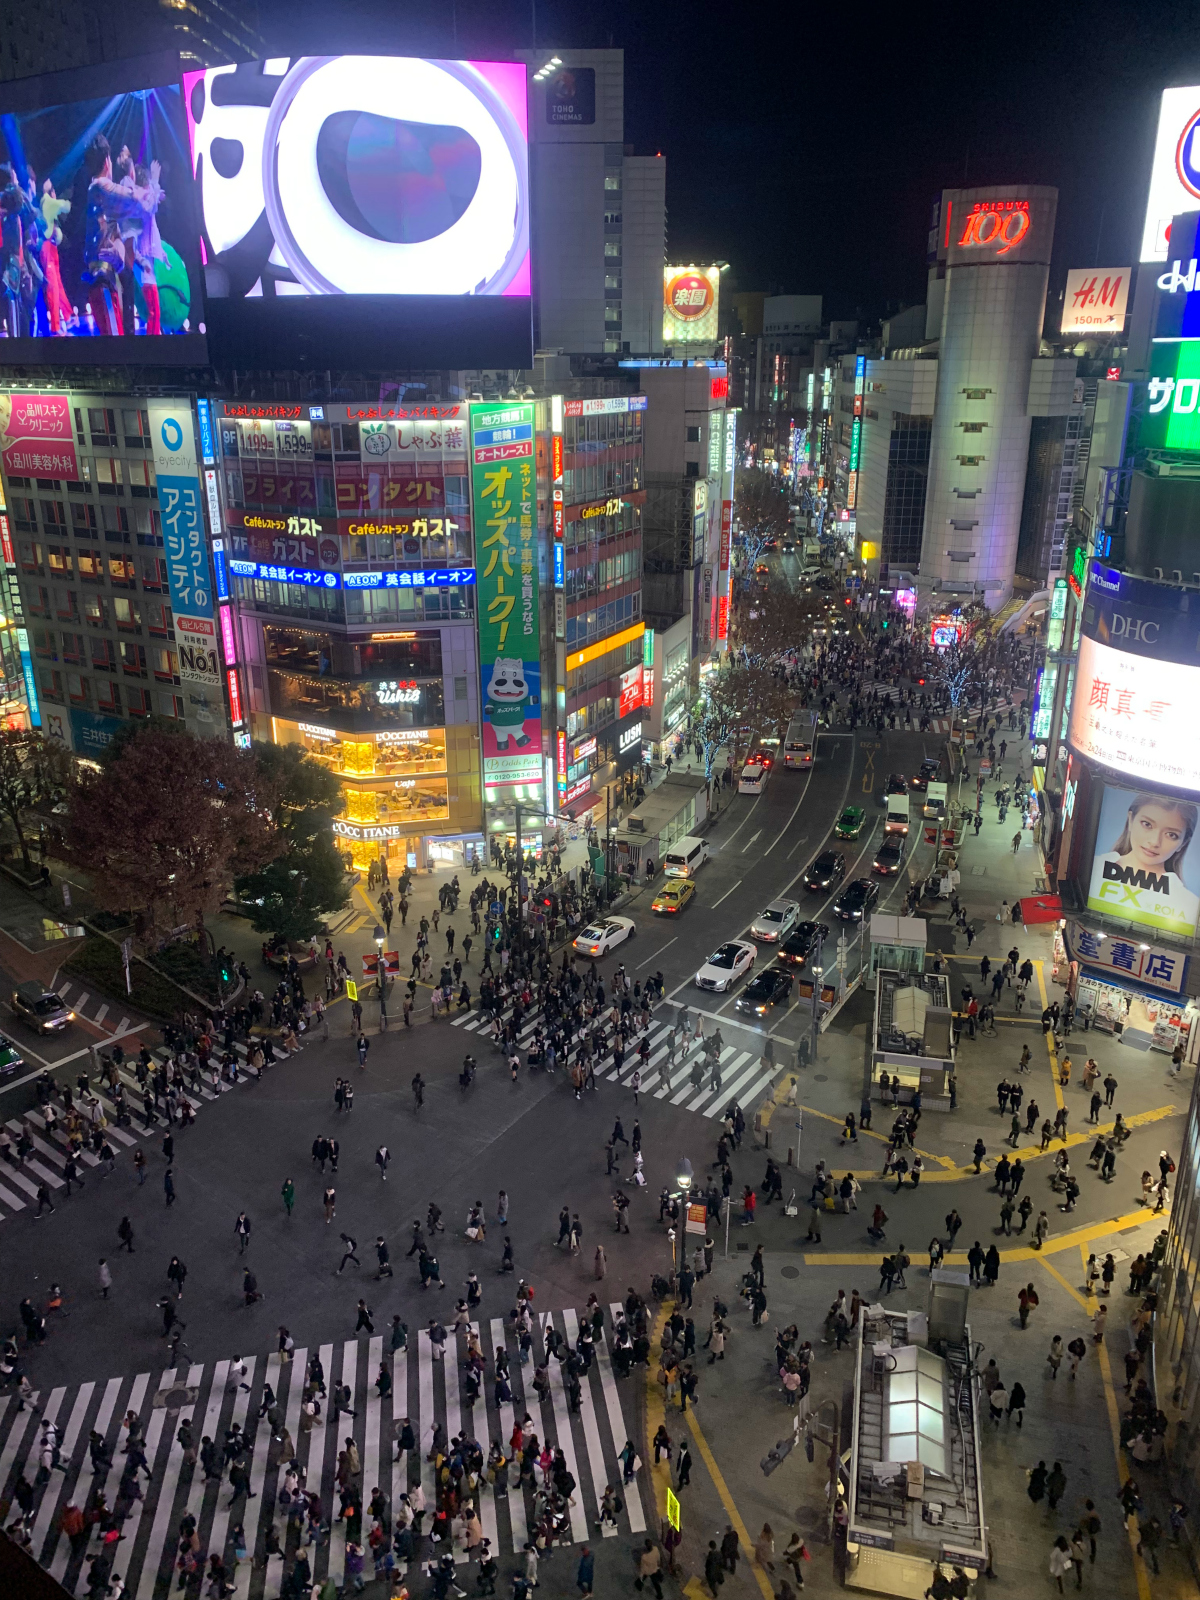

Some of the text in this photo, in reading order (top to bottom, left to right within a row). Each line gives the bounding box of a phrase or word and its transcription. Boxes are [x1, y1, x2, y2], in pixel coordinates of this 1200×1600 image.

[552, 105, 574, 113] TOHO
[552, 113, 582, 121] CINEMAS
[973, 201, 1030, 212] SHIBUYA
[957, 210, 1030, 254] 109
[674, 288, 707, 306] 楽園
[1072, 275, 1123, 309] H&M
[1075, 315, 1102, 325] 150m
[27, 404, 66, 418] 品川スキン
[224, 404, 302, 419] しゃぶしゃぶバイキング
[347, 406, 461, 419] しゃぶしゃぶバイキング
[29, 418, 64, 432] クリニック
[200, 407, 211, 455] 東急リバブル
[222, 431, 237, 444] 9F
[397, 427, 463, 450] しゃぶ葉
[725, 413, 735, 473] BIC CAMERA
[13, 452, 74, 473] 品川美容外科
[158, 455, 192, 469] eyecity
[244, 477, 314, 500] プライス
[338, 481, 441, 502] コンタクト
[847, 475, 856, 506] HOOTERS
[606, 498, 625, 517] ガスト
[287, 517, 323, 537] ガスト
[412, 518, 459, 537] ガスト
[162, 487, 190, 605] アイシティ
[183, 489, 208, 607] コンタクトの
[233, 536, 248, 551] 7F
[272, 538, 315, 564] ガスト
[519, 463, 534, 636] ネットで馬券・車券を買うなら
[721, 529, 730, 564] TaxFree
[234, 564, 255, 575] AEON
[259, 565, 322, 584] 英会話イーオン
[325, 573, 335, 584] 6F
[349, 574, 380, 587] AEON
[386, 572, 473, 587] 英会話イーオン
[1097, 576, 1120, 592] Channel
[181, 620, 211, 634] 当ビル5階
[1111, 613, 1160, 644] DHC
[177, 644, 219, 676] No.1
[181, 671, 220, 684] コンタクトショップ
[376, 688, 421, 704] Ushi8
[624, 685, 639, 703] アコム
[298, 722, 336, 738] L'OCCITANE
[376, 730, 429, 742] L'OCCITANE
[619, 721, 642, 749] LUSH
[501, 757, 540, 768] Odds Park
[394, 779, 416, 788] Café
[494, 771, 540, 781] 0120-953-620
[1103, 860, 1170, 896] DMM
[1098, 881, 1144, 909] FX
[1154, 903, 1186, 920] ROLA
